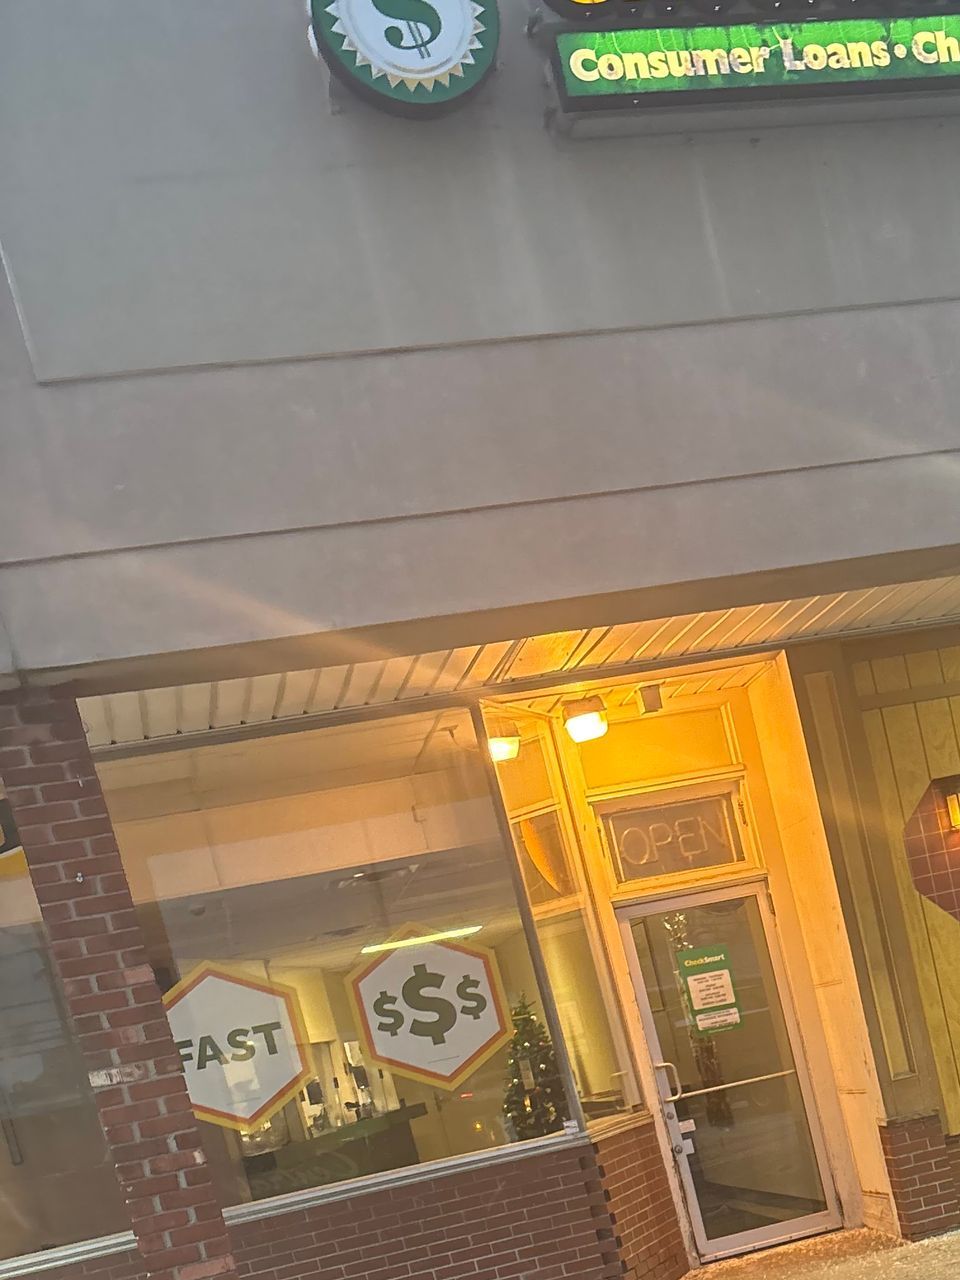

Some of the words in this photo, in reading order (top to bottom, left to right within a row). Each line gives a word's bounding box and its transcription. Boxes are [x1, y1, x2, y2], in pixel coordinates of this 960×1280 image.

[569, 46, 770, 81] Consumer
[620, 807, 728, 865] OPEN
[175, 1021, 282, 1073] FAST
